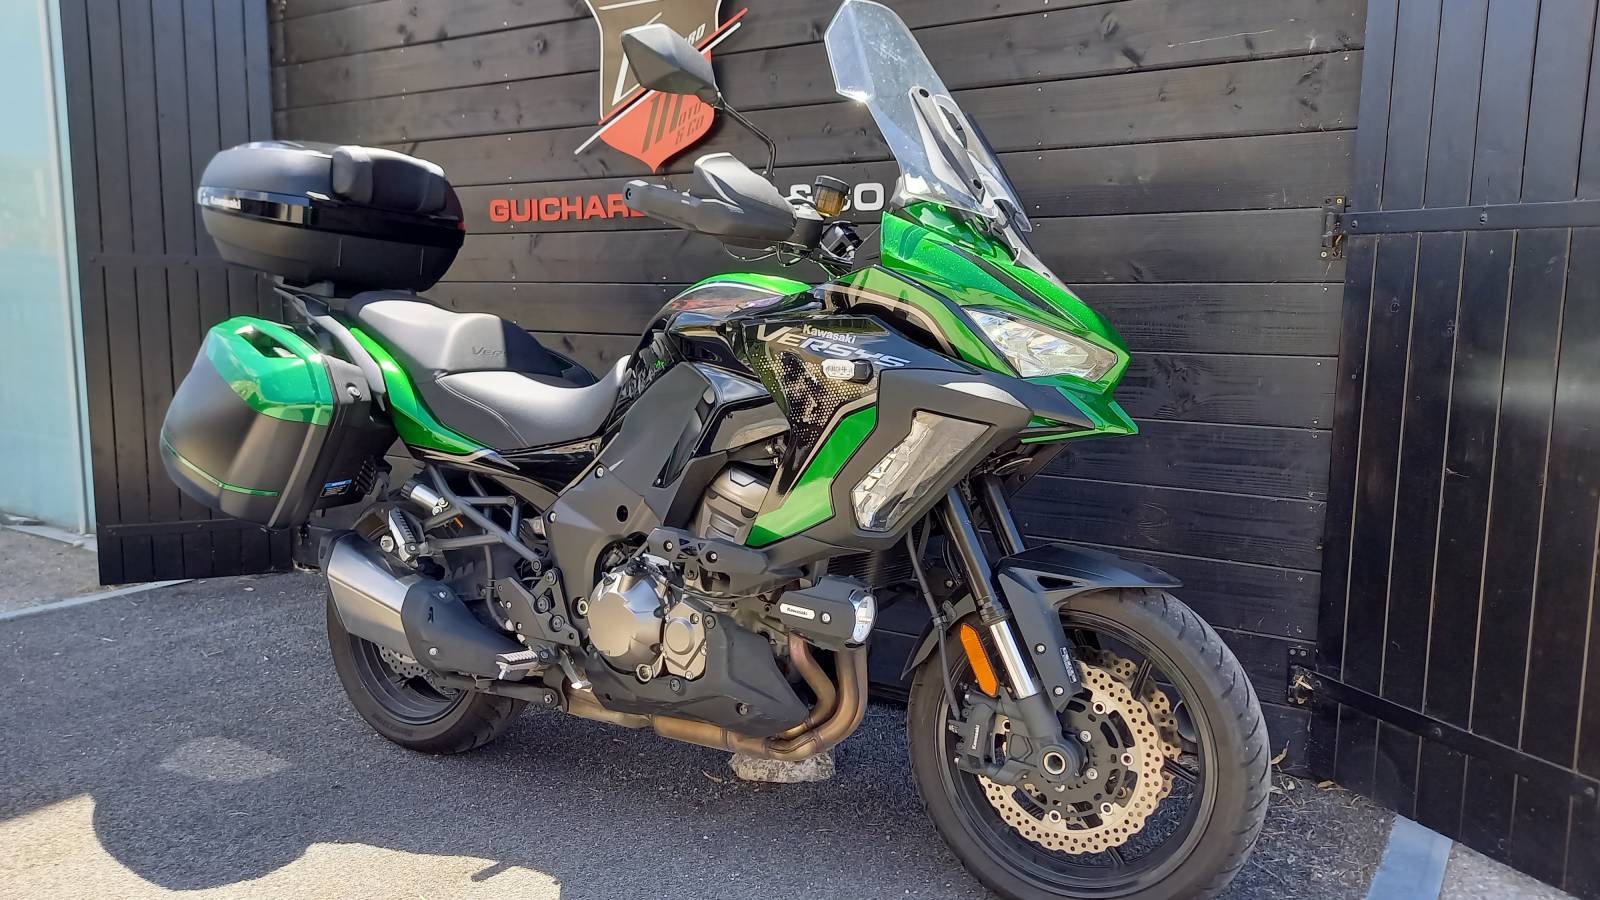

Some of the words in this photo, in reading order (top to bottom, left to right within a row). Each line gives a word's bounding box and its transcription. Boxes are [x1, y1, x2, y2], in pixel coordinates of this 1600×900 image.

[489, 194, 646, 222] GUICHAR
[756, 323, 911, 367] VERSYS
[802, 323, 856, 344] Kawasaki
